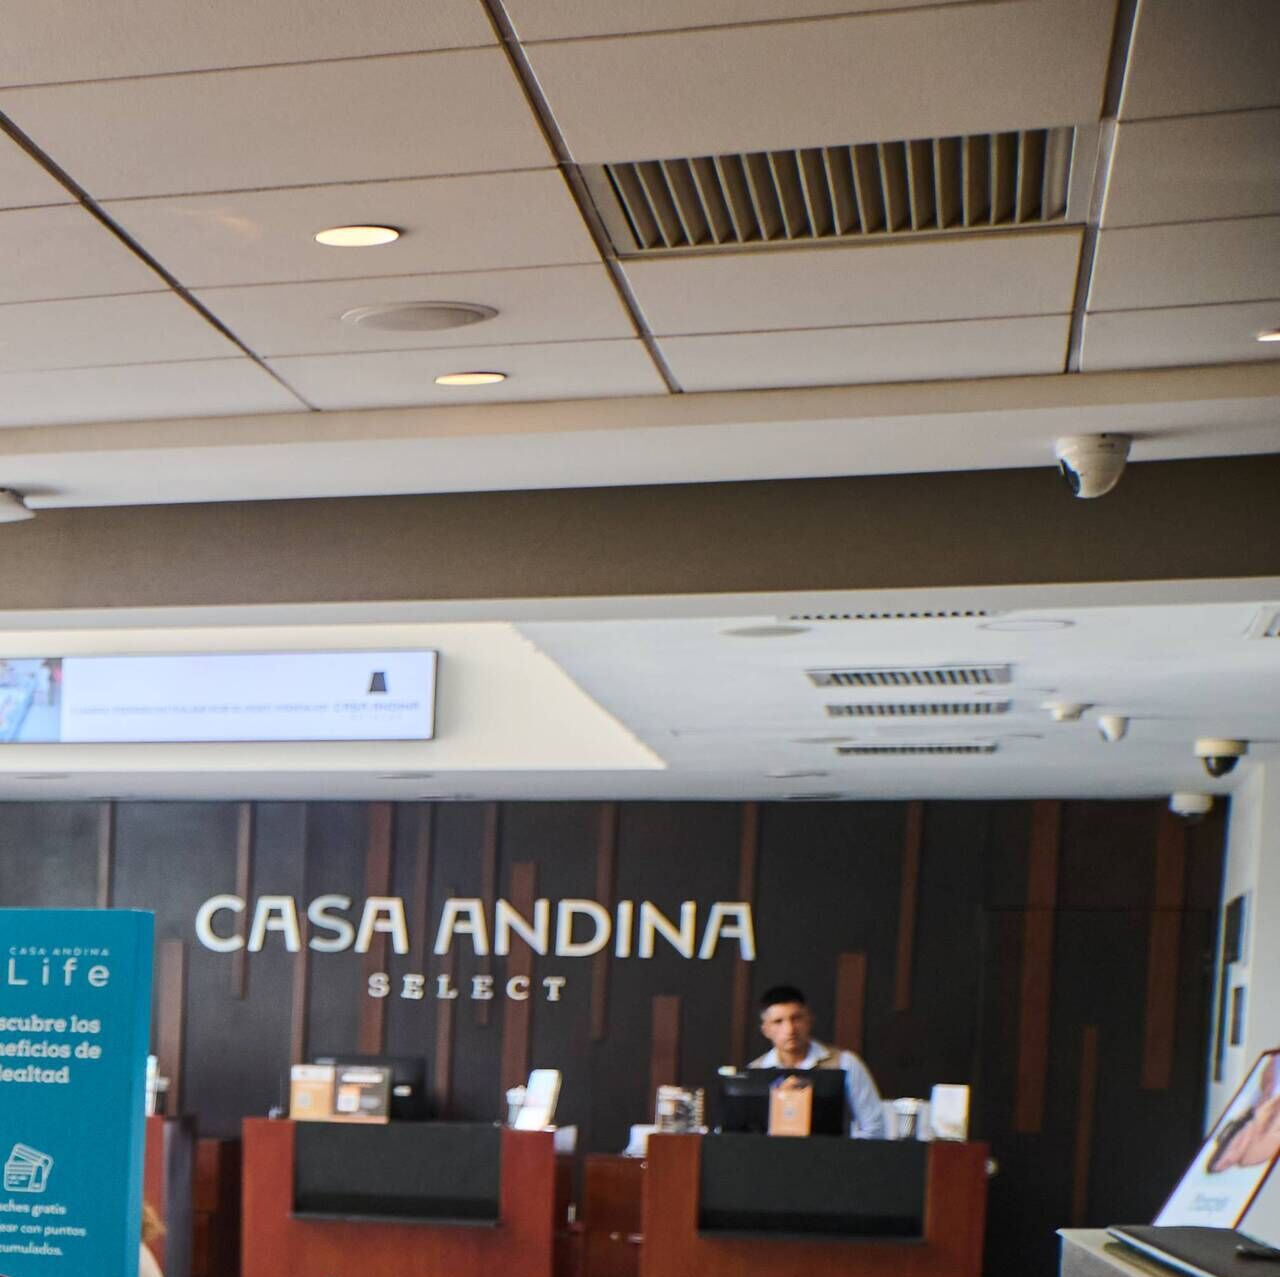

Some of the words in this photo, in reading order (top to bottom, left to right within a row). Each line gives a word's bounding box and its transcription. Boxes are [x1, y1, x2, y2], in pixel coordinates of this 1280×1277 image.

[195, 893, 410, 955] CASA
[433, 897, 757, 962] ANDINA
[8, 946, 47, 956] CASA
[51, 947, 110, 957] ANDINA
[7, 957, 111, 988] Life
[367, 971, 567, 1002] SELECT
[70, 1014, 102, 1034] los
[74, 1040, 103, 1060] de
[31, 1203, 67, 1218] gratis
[20, 1224, 42, 1234] con
[43, 1225, 87, 1237] puntos
